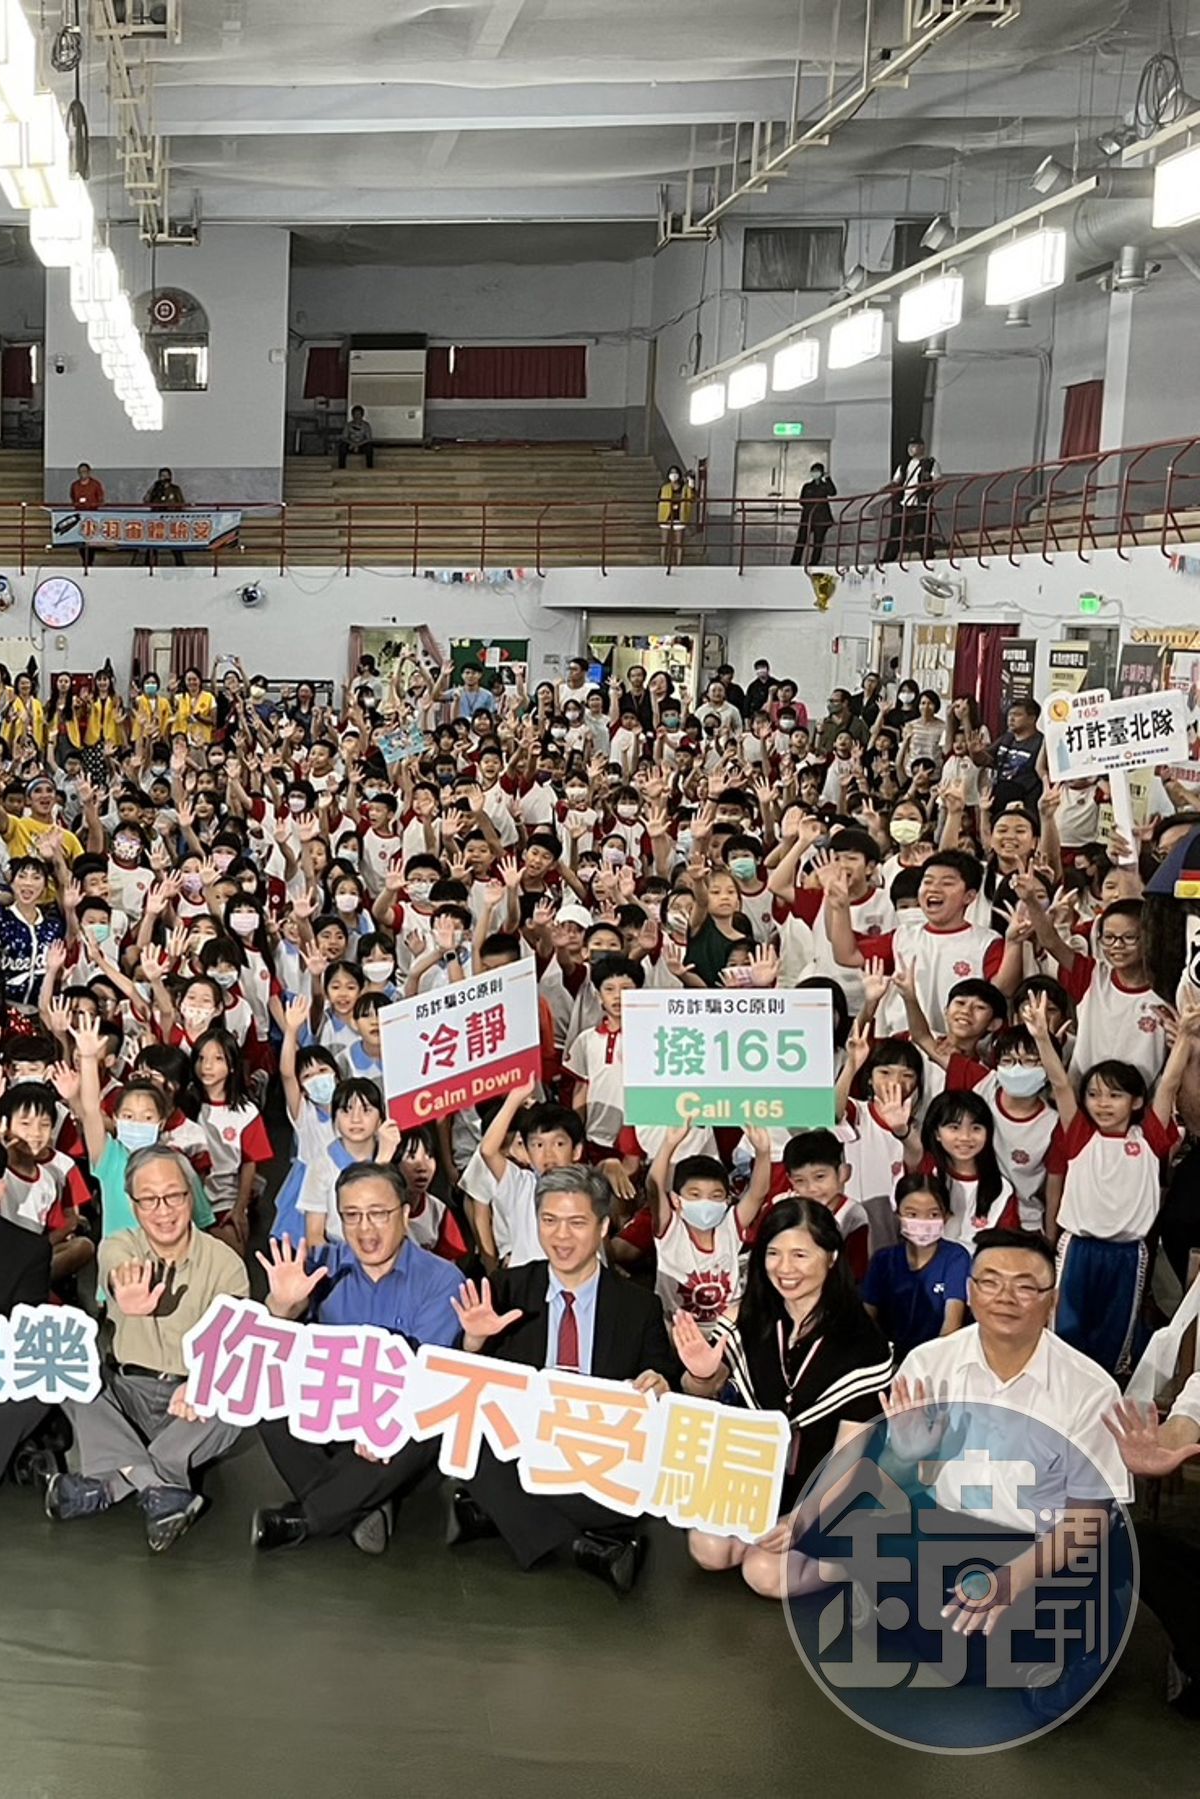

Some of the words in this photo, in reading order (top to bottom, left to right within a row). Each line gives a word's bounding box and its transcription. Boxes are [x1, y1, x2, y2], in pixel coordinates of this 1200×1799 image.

[1065, 708, 1175, 753] 打詐臺北隊
[416, 977, 503, 1020] 防詐騙3C原則
[667, 998, 785, 1015] 防詐騙3C原則
[418, 1002, 507, 1076] 冷靜
[653, 1025, 808, 1077] 撥165
[413, 1087, 467, 1117] Calm
[471, 1067, 522, 1097] Down
[675, 1091, 731, 1119] Call
[740, 1100, 785, 1118] 165
[190, 1303, 782, 1535] 你我不受騙
